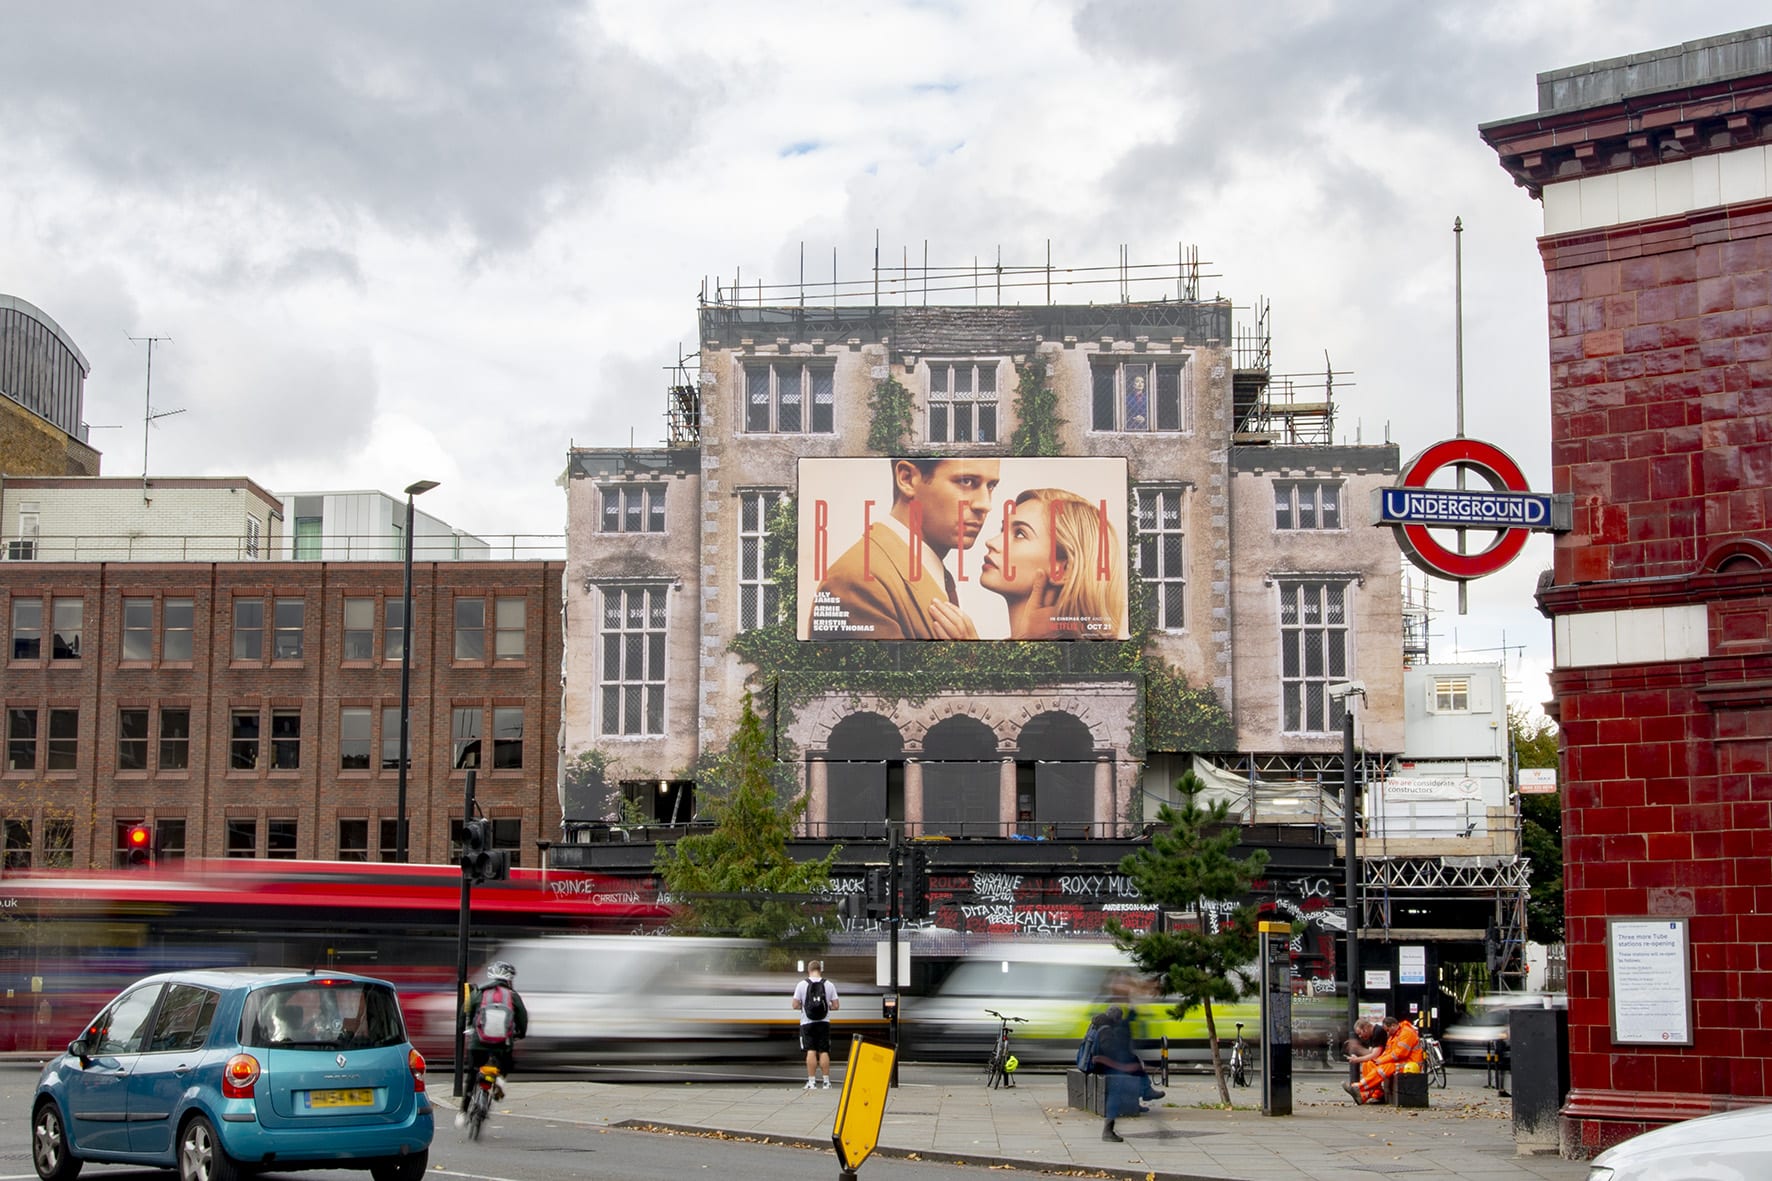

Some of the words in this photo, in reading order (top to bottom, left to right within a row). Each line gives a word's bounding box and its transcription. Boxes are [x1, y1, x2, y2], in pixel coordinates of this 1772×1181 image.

[1387, 493, 1545, 523] UNDERGROUND
[814, 500, 1111, 582] REBECCA
[1413, 779, 1454, 787] considerate
[830, 878, 865, 892] BLACK
[1059, 875, 1104, 897] ROXY
[1109, 875, 1143, 897] MUS
[961, 904, 990, 918] DITA
[990, 904, 1013, 916] VON
